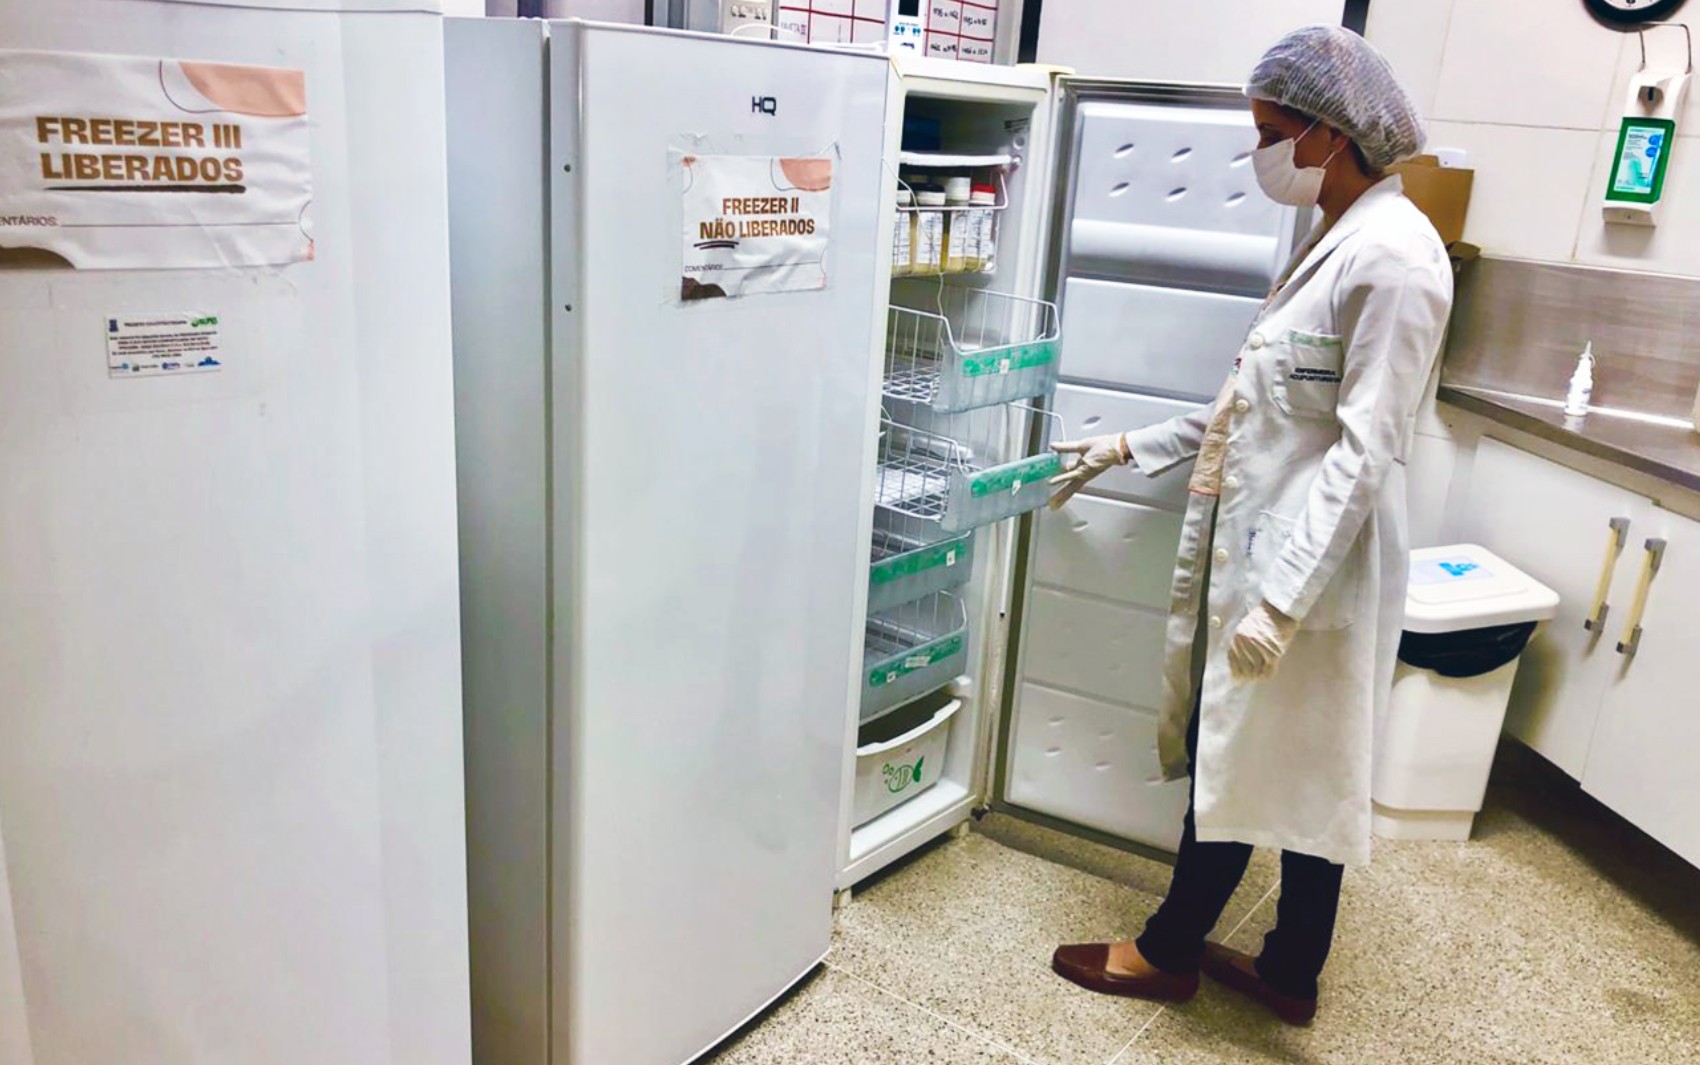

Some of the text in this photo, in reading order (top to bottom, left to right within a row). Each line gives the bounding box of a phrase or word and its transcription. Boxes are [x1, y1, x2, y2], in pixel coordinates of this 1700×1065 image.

[751, 95, 777, 117] HQ
[36, 117, 241, 148] FREEZER III
[40, 153, 244, 182] LIBERADOS
[722, 197, 799, 215] FREEZER II
[700, 217, 815, 239] NÃO LIBERADOS
